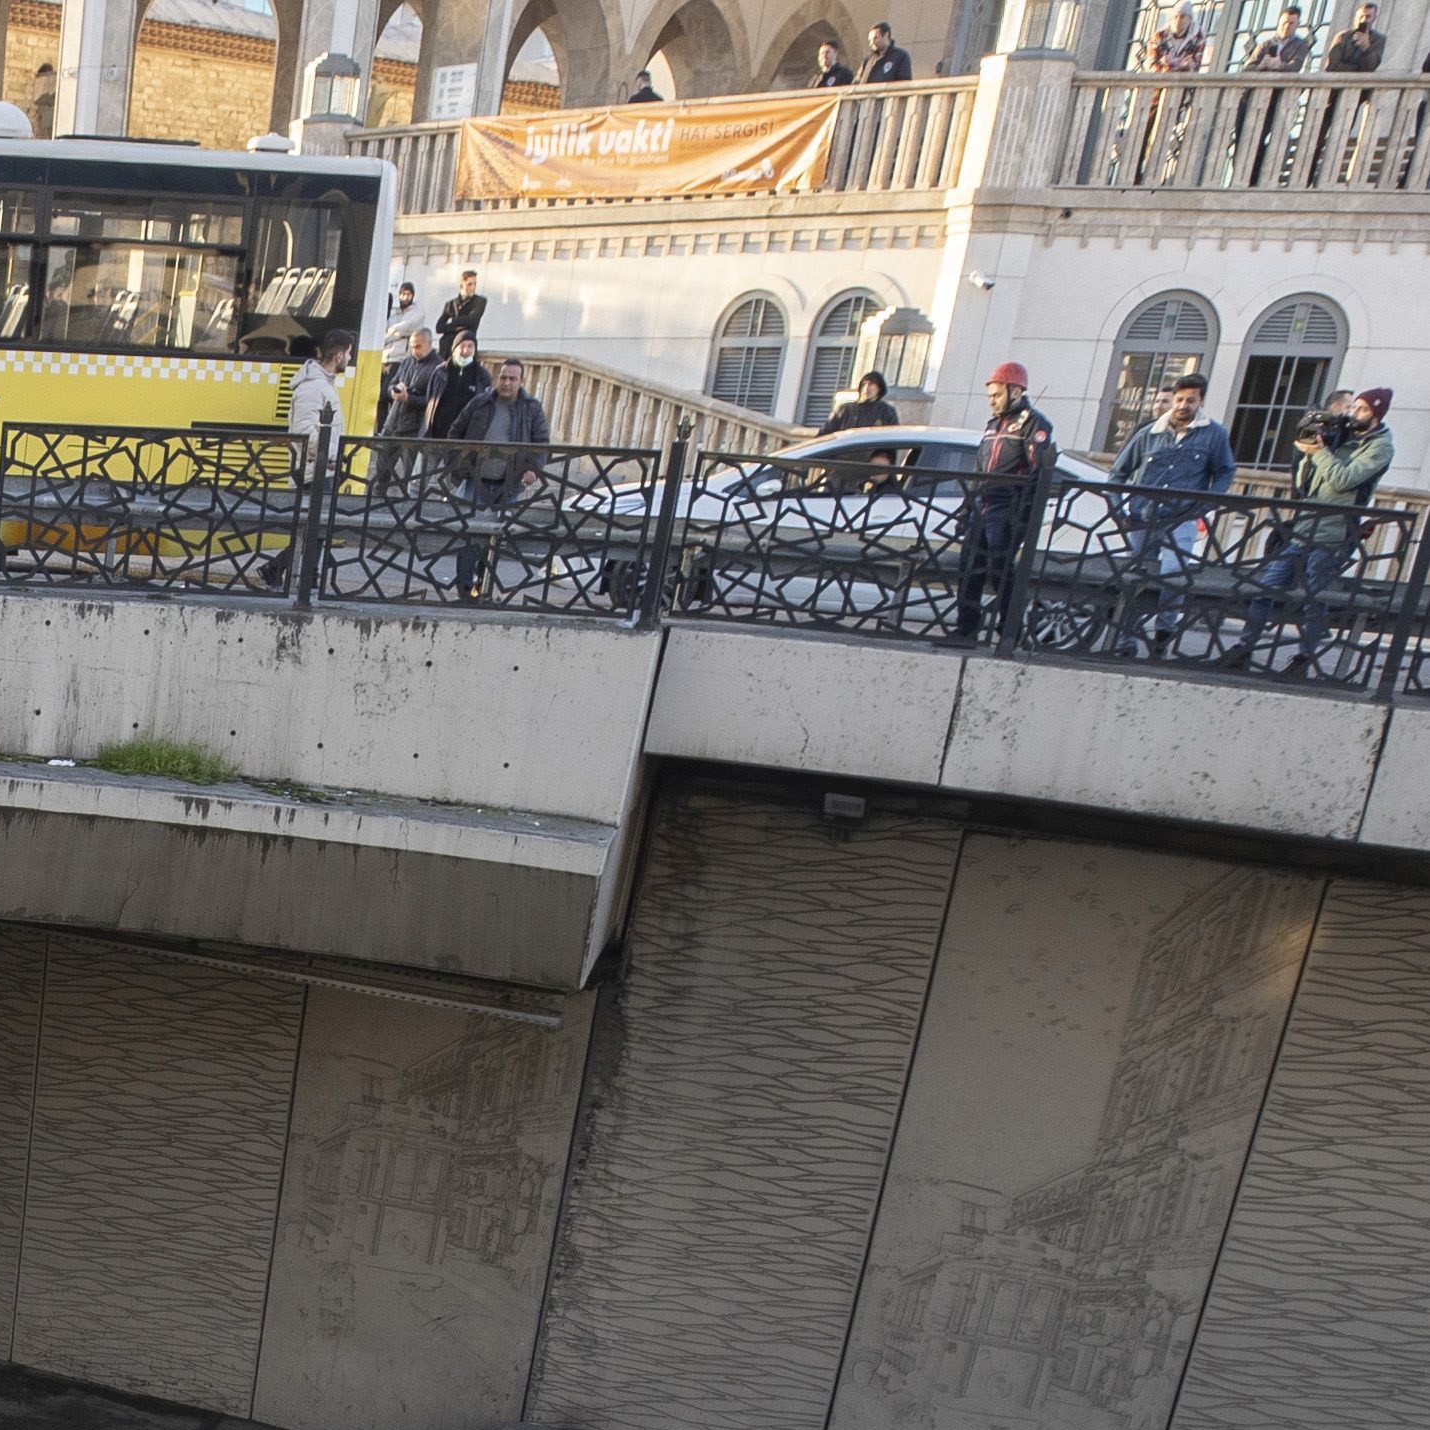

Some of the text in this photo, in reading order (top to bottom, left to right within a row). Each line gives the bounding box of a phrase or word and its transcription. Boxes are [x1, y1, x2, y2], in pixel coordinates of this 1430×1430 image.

[524, 117, 676, 165] iyilik vakti
[680, 118, 775, 141] HAT SERGİSİ
